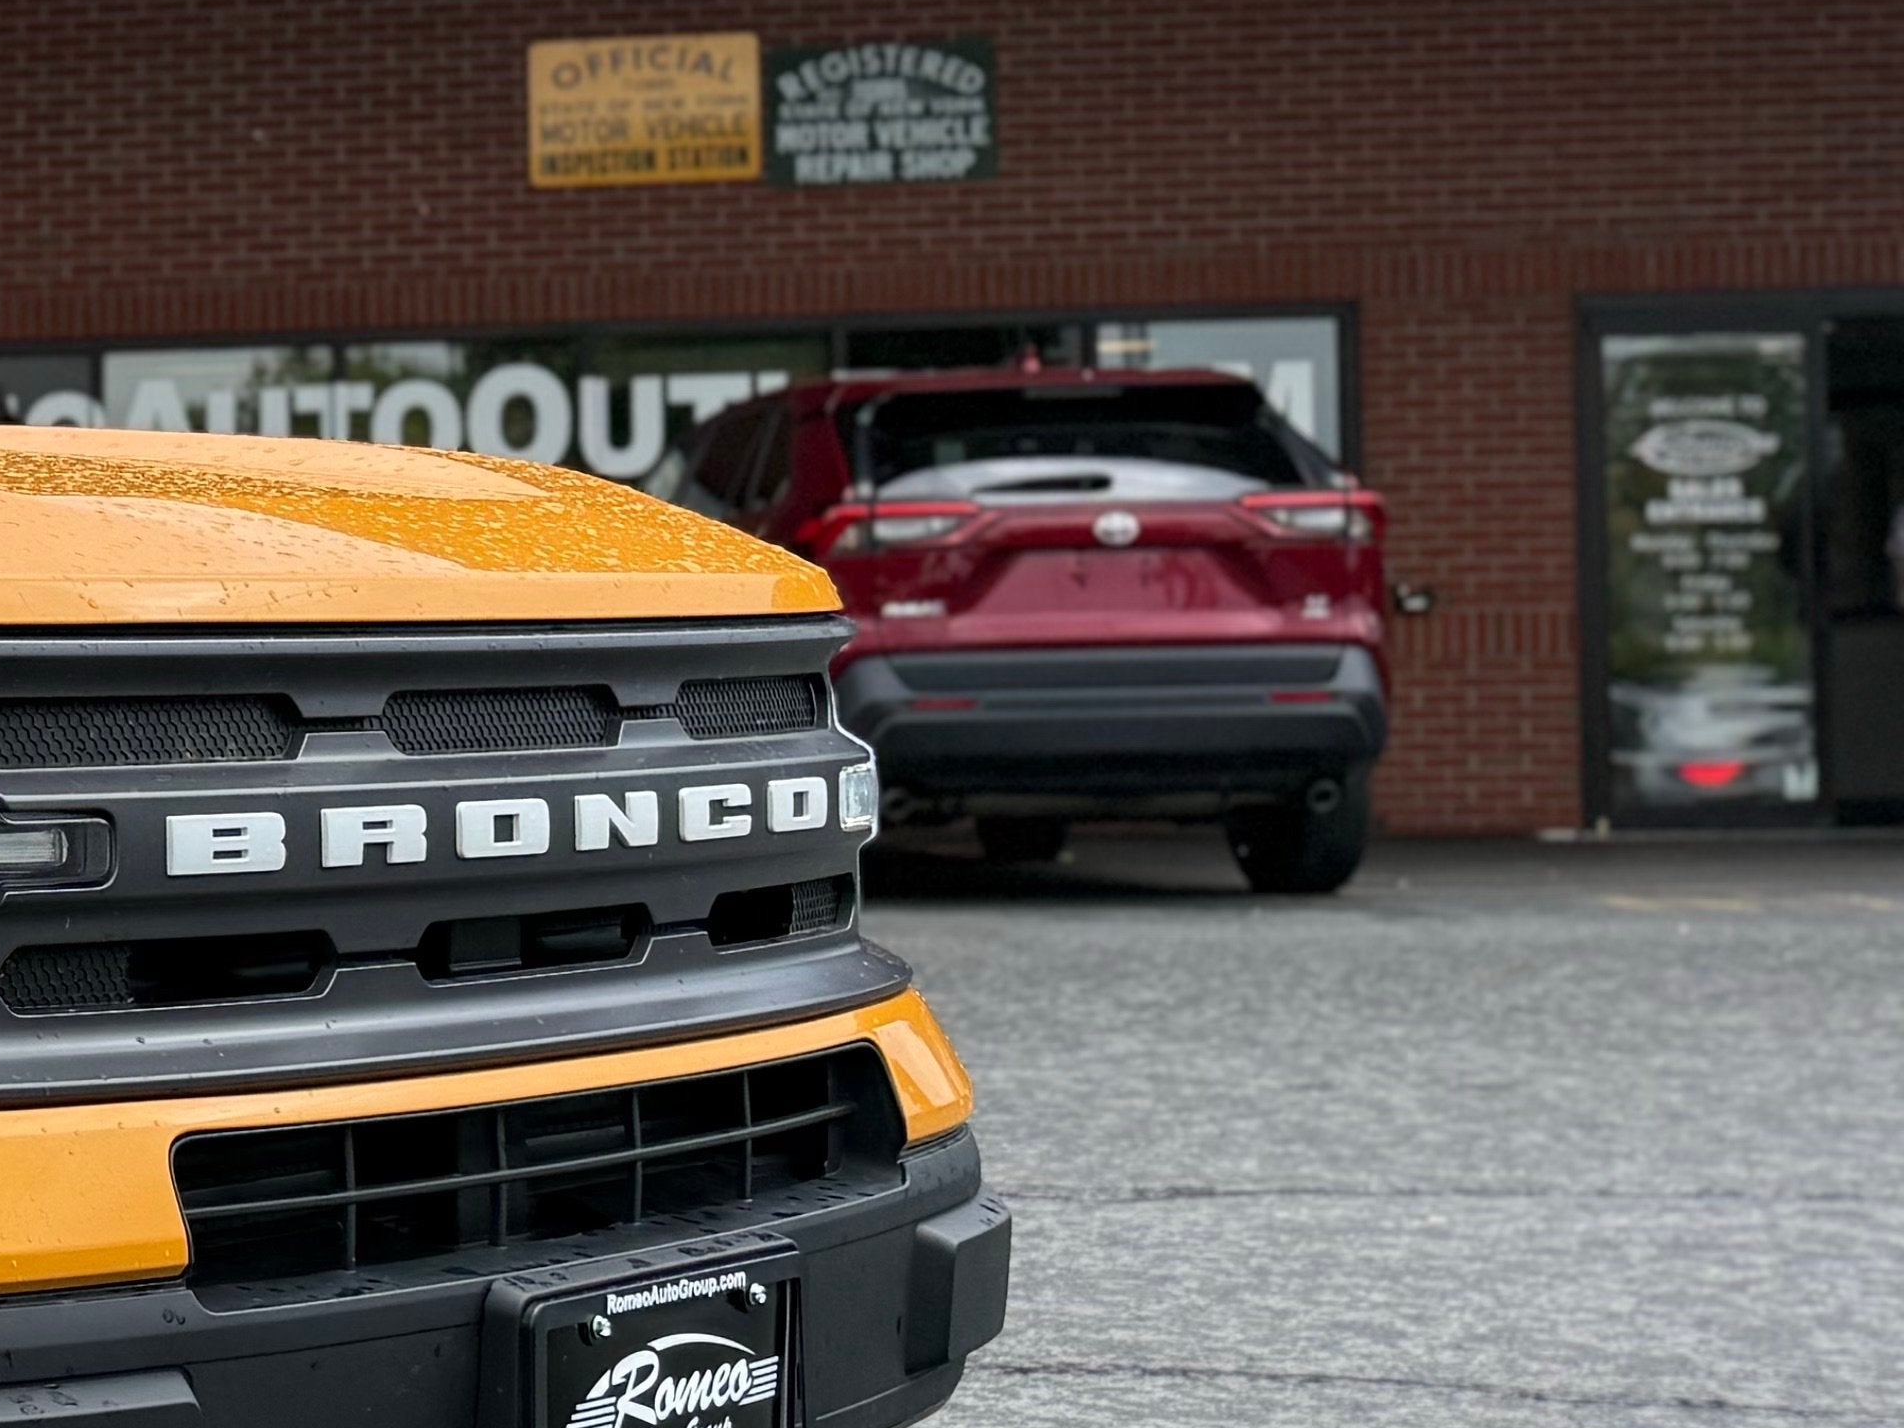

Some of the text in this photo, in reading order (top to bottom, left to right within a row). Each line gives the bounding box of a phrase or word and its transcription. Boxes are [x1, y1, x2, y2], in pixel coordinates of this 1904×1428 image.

[550, 43, 734, 90] OFFICIAL
[777, 43, 988, 100] REGISTERED
[539, 111, 749, 144] MOTOR VEHICLE
[777, 116, 991, 151] MOTOR VEHICLE
[541, 143, 750, 174] INSPECTION STATION
[794, 148, 978, 182] REPAIR SHOP
[165, 775, 830, 877] BRONCO
[606, 1270, 747, 1315] RomeoAutoGroup.com
